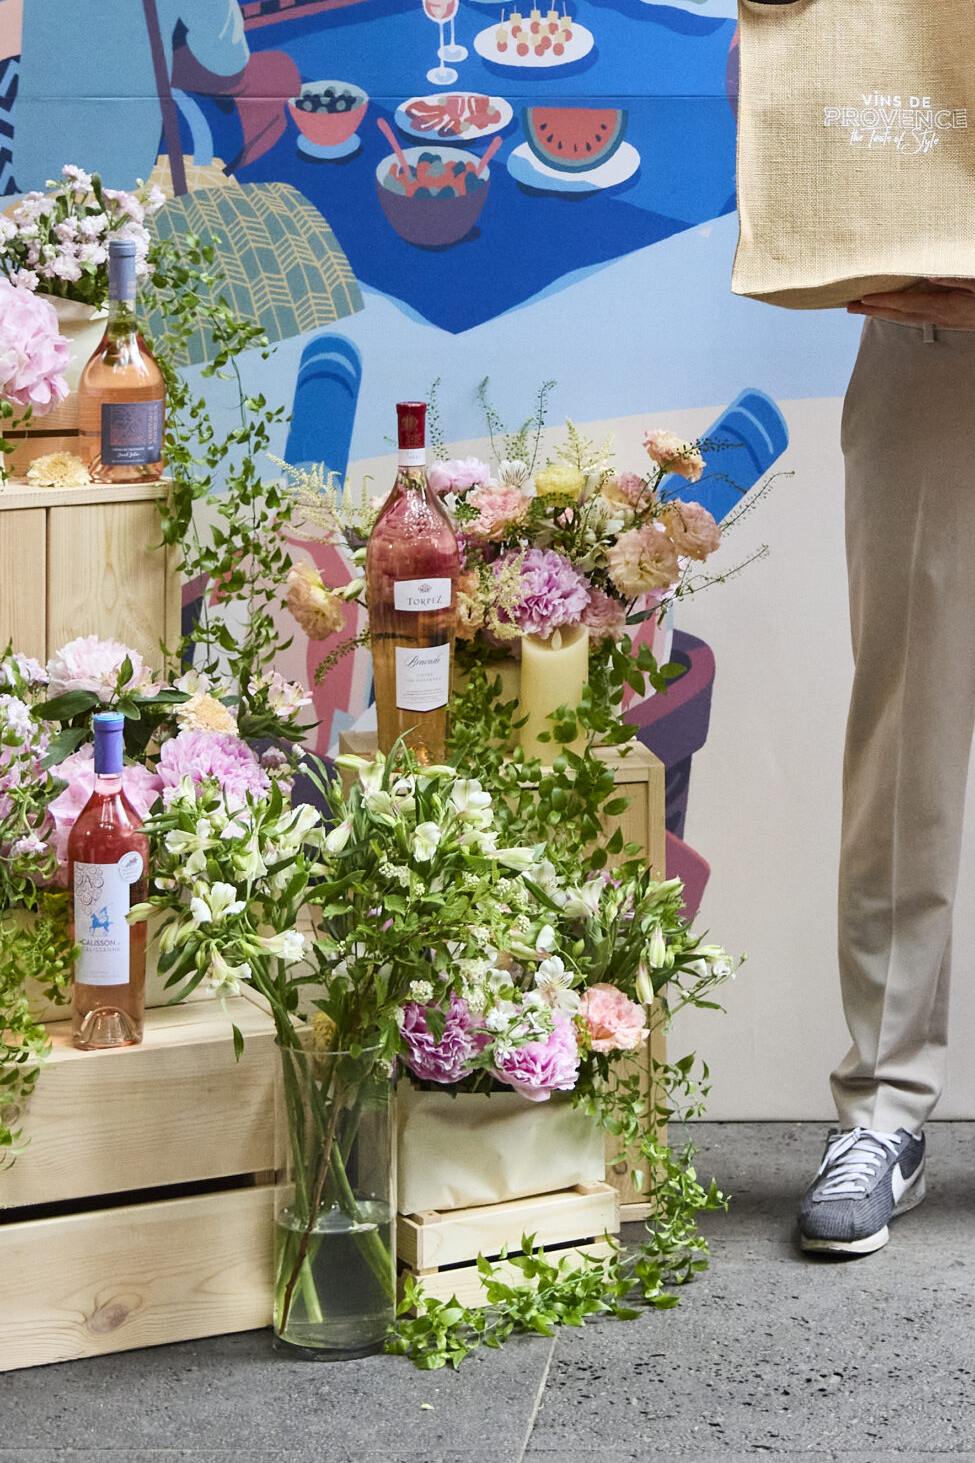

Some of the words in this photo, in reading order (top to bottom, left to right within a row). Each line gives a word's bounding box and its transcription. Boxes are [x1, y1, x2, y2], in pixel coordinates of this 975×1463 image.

[909, 96, 931, 108] DE
[823, 106, 968, 130] PROVENCE
[893, 130, 905, 149] of
[900, 128, 939, 155] Style
[407, 594, 442, 607] TORPEZ
[81, 938, 116, 947] CALISSON
